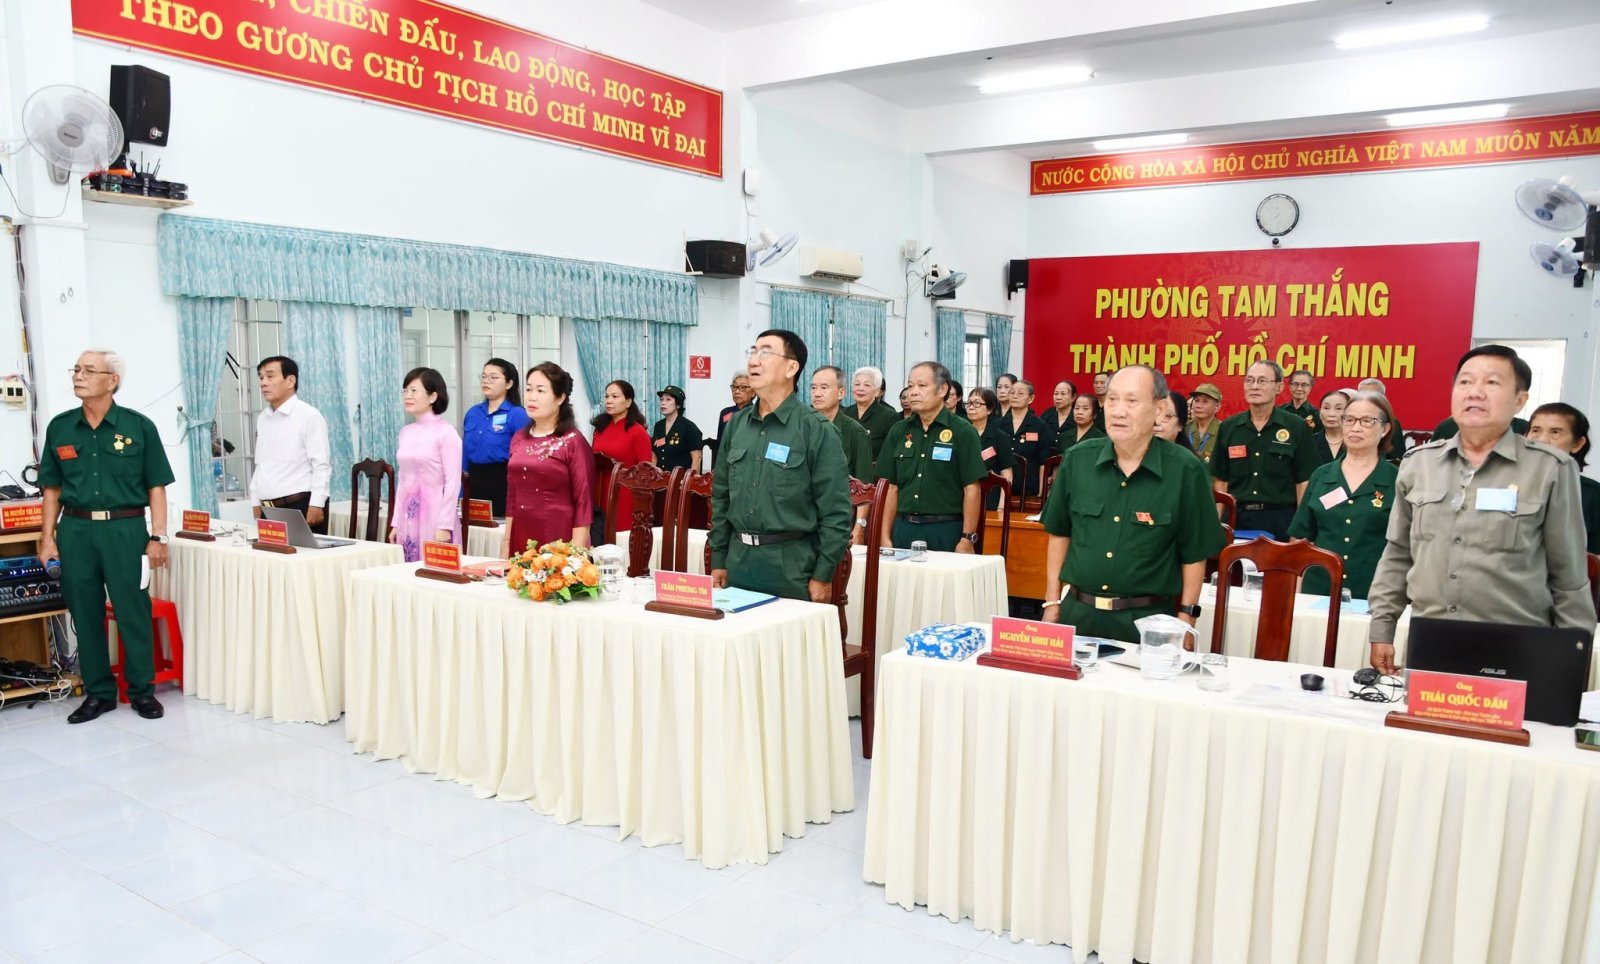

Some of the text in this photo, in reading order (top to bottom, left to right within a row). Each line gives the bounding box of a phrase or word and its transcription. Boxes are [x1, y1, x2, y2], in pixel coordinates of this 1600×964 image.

[120, 0, 706, 160] THEO GƯƠNG CHỦ TỊCH HỒ CHÍ MINH VĨ ĐẠI
[399, 16, 464, 61] ĐẤU,
[474, 40, 521, 73] LAO
[528, 56, 596, 97] ĐỘNG,
[603, 78, 645, 108] HỌC
[651, 92, 686, 120] TẬP
[1041, 124, 1600, 186] NƯỚC CỘNG HÒA XÃ HỘI CHỦ NGHĨA VIỆT NAM MUÔN NĂM
[1095, 267, 1389, 318] PHƯỜNG TAM THẮNG
[1070, 336, 1156, 373] THÀNH
[1164, 331, 1222, 375] PHỐ
[1276, 335, 1329, 378] CHÍ
[1335, 345, 1415, 378] MINH
[1480, 667, 1507, 675] ASUS
[1419, 690, 1446, 704] THÁI
[1447, 691, 1481, 708] QUỐC
